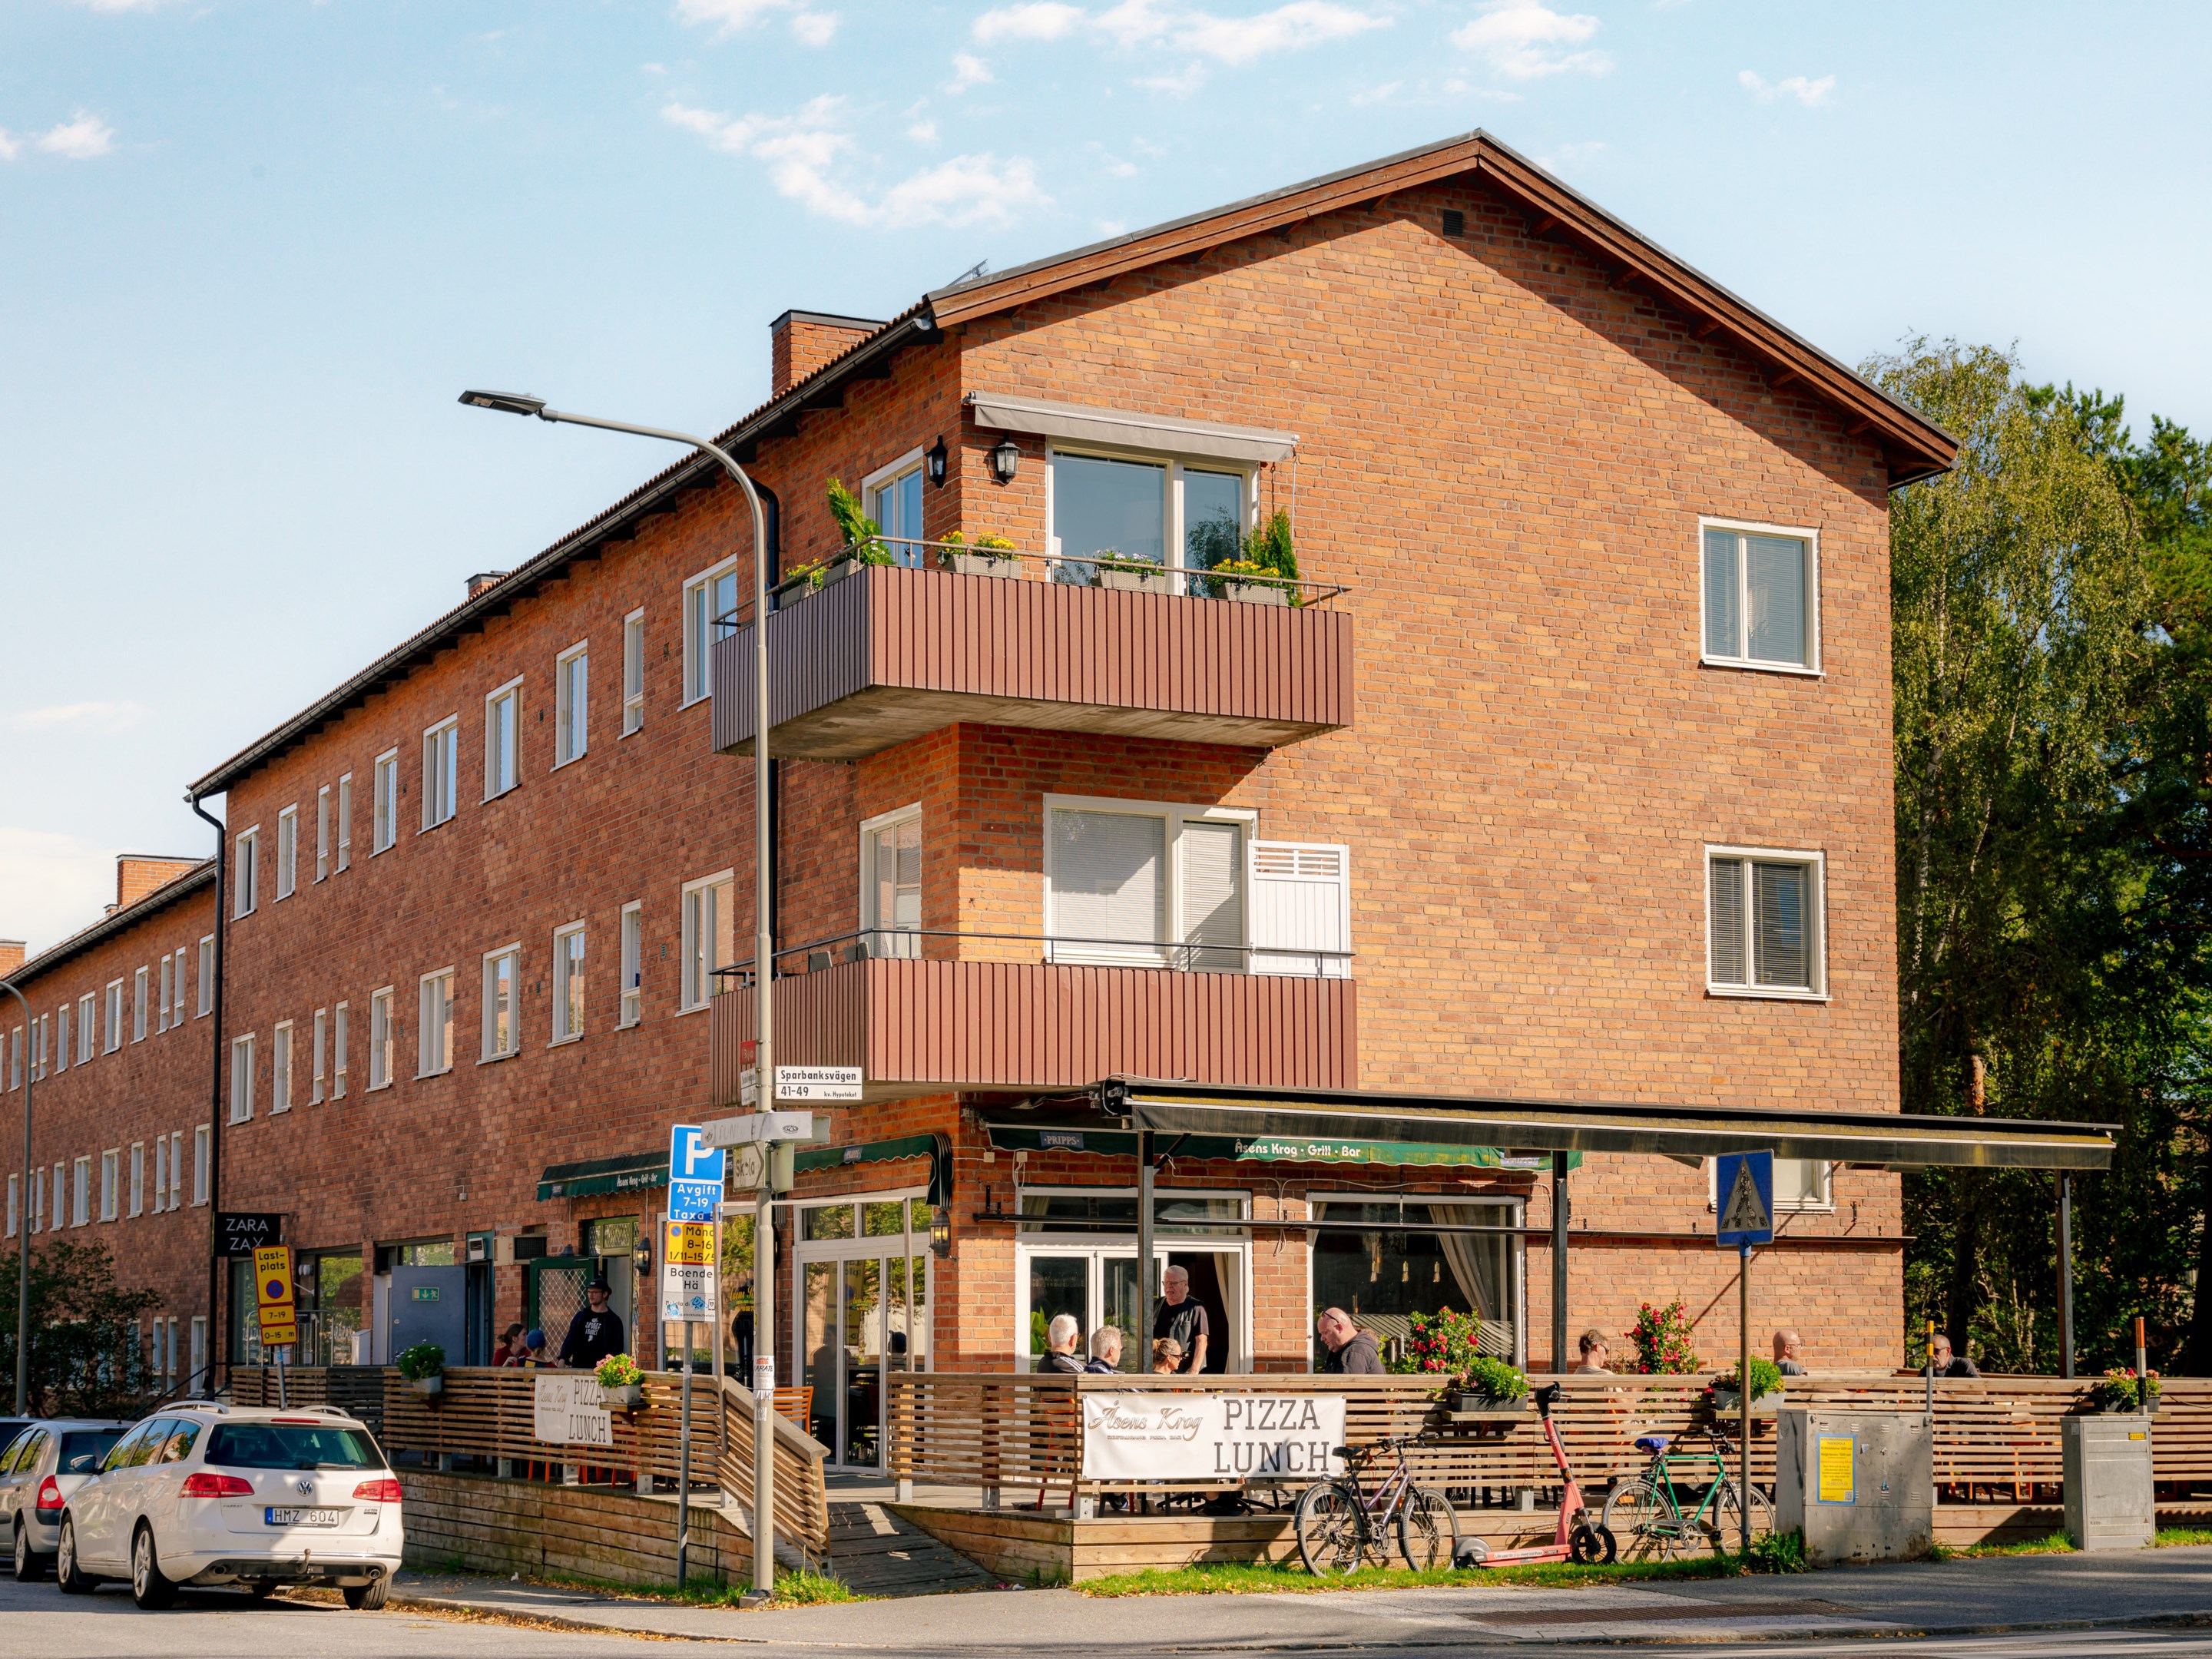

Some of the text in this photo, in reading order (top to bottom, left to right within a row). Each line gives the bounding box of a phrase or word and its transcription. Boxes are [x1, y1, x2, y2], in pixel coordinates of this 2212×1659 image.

[780, 1070, 856, 1082] Sparbanksvägen
[780, 1086, 809, 1097] 41-49
[1047, 1135, 1077, 1145] PRIPPS
[685, 1131, 715, 1175] P
[1235, 1138, 1361, 1157] Åsens Krog Grill Bar
[677, 1184, 716, 1197] Avgift
[683, 1197, 708, 1207] 7-19
[674, 1209, 704, 1220] Taxa
[226, 1218, 269, 1231] ZARA
[230, 1237, 263, 1250] ZAX
[687, 1240, 712, 1250] 8-16
[258, 1251, 285, 1260] Last-
[260, 1262, 286, 1273] plats
[671, 1267, 713, 1278] Boende
[574, 1379, 602, 1406] PIZZA
[1088, 1399, 1204, 1442] Åsens Krog
[1224, 1399, 1321, 1430] PIZZA
[568, 1414, 607, 1442] LUNCH
[1214, 1441, 1330, 1473] LUNCH
[274, 1510, 336, 1523] HMZ 604
